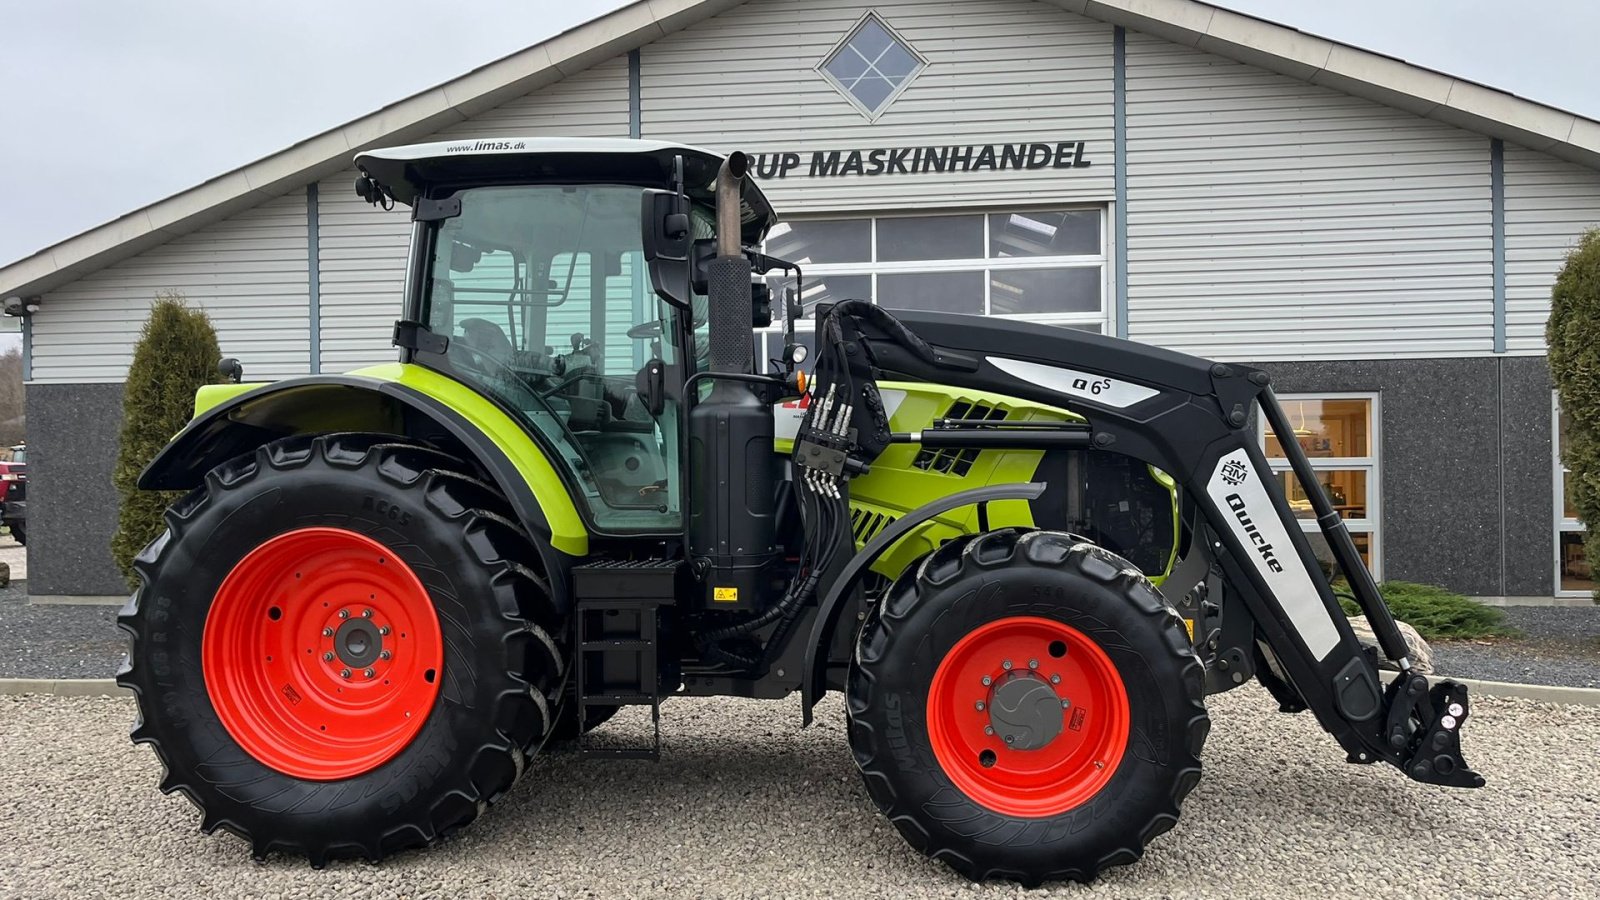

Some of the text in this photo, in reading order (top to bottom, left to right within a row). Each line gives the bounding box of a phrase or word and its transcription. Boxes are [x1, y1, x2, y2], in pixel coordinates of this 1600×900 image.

[446, 141, 527, 153] www.limas.dk
[808, 141, 1092, 178] MASKINHANDEL
[1225, 493, 1284, 574] Quicke
